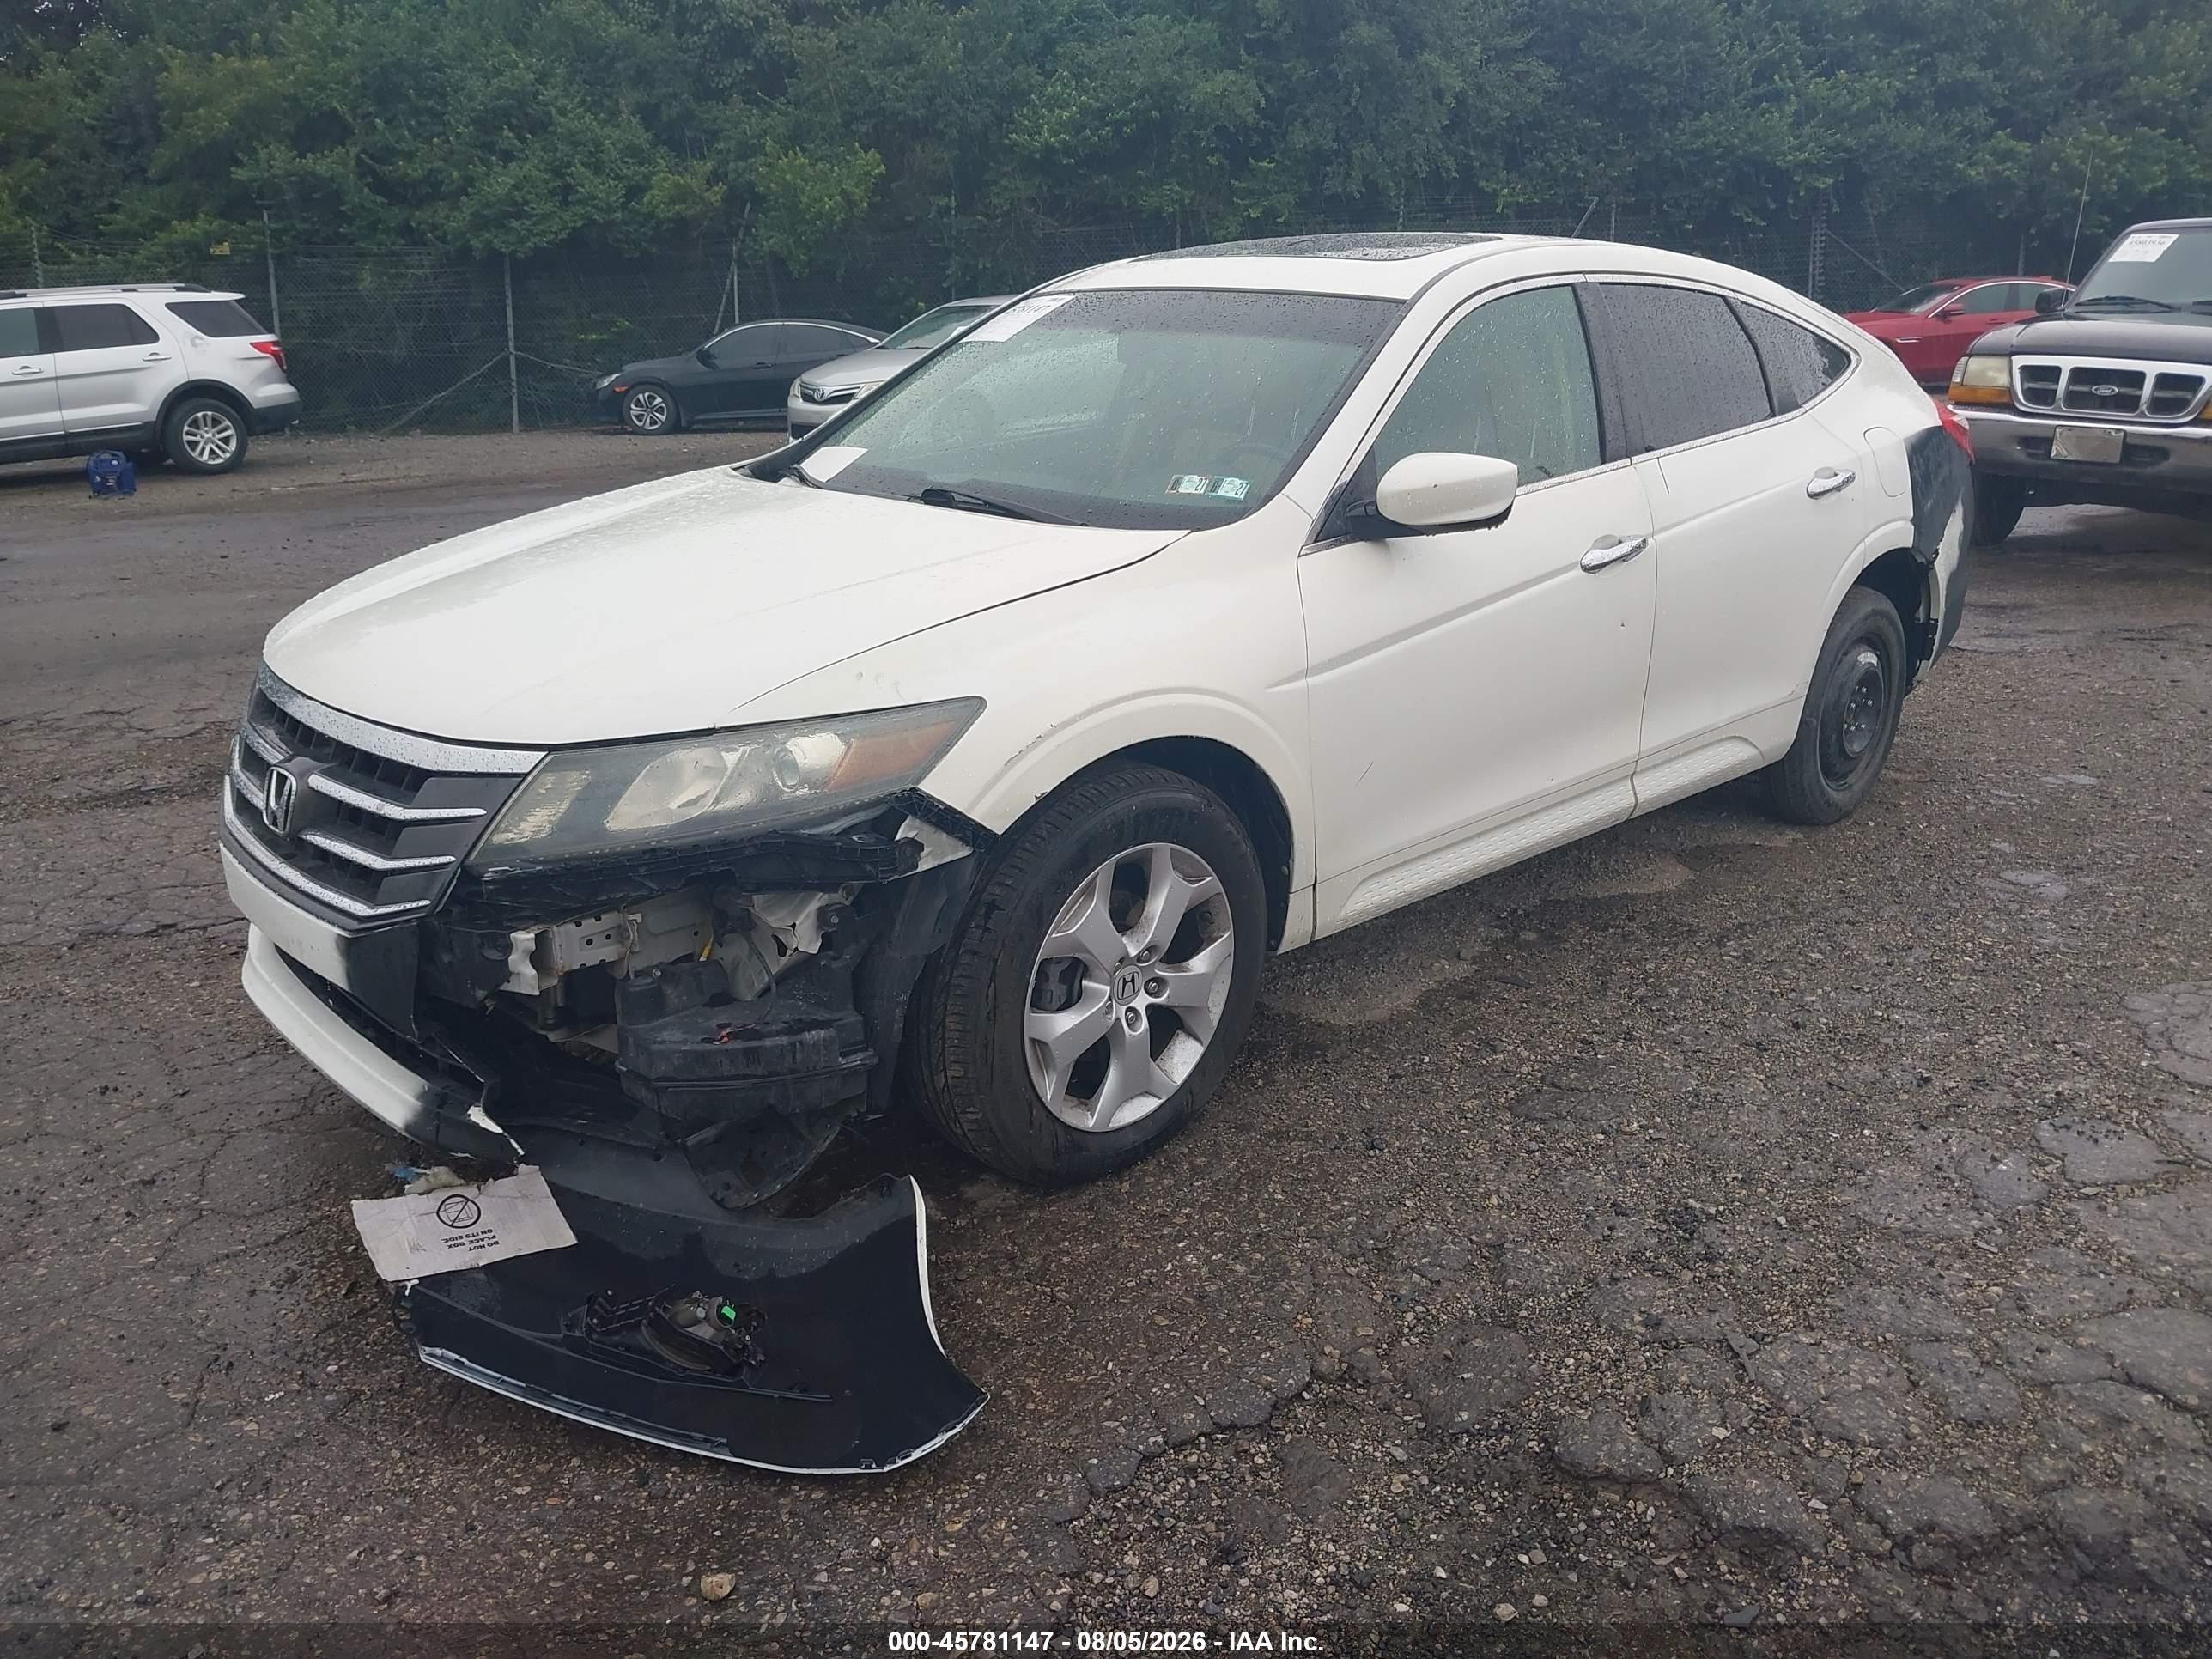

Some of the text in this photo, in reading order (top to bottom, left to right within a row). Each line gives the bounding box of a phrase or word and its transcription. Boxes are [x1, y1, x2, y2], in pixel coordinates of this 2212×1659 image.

[1194, 478, 1208, 492] 27
[1234, 482, 1249, 496] 27
[468, 1234, 496, 1244] PLACE
